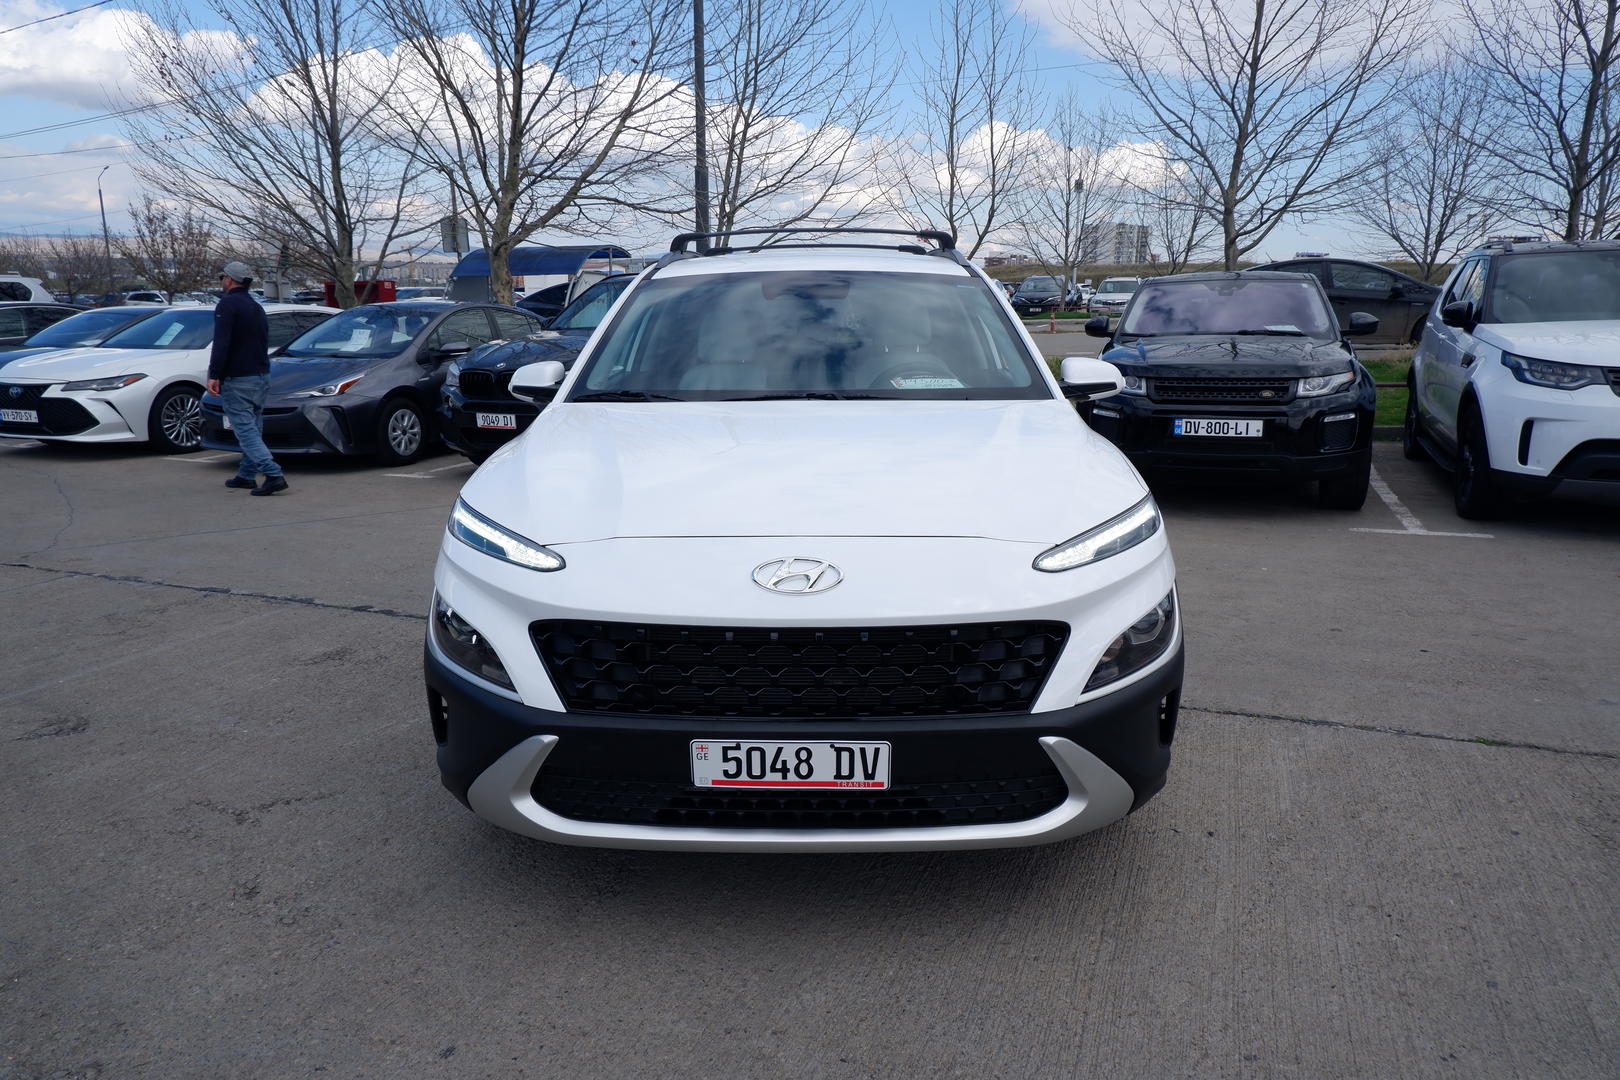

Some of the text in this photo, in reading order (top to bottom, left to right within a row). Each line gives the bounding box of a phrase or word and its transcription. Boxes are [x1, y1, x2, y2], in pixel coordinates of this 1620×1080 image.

[481, 414, 500, 426] 9049
[1184, 420, 1249, 436] DV-800-LI
[696, 752, 709, 761] GE
[722, 743, 880, 780] 5048 DV
